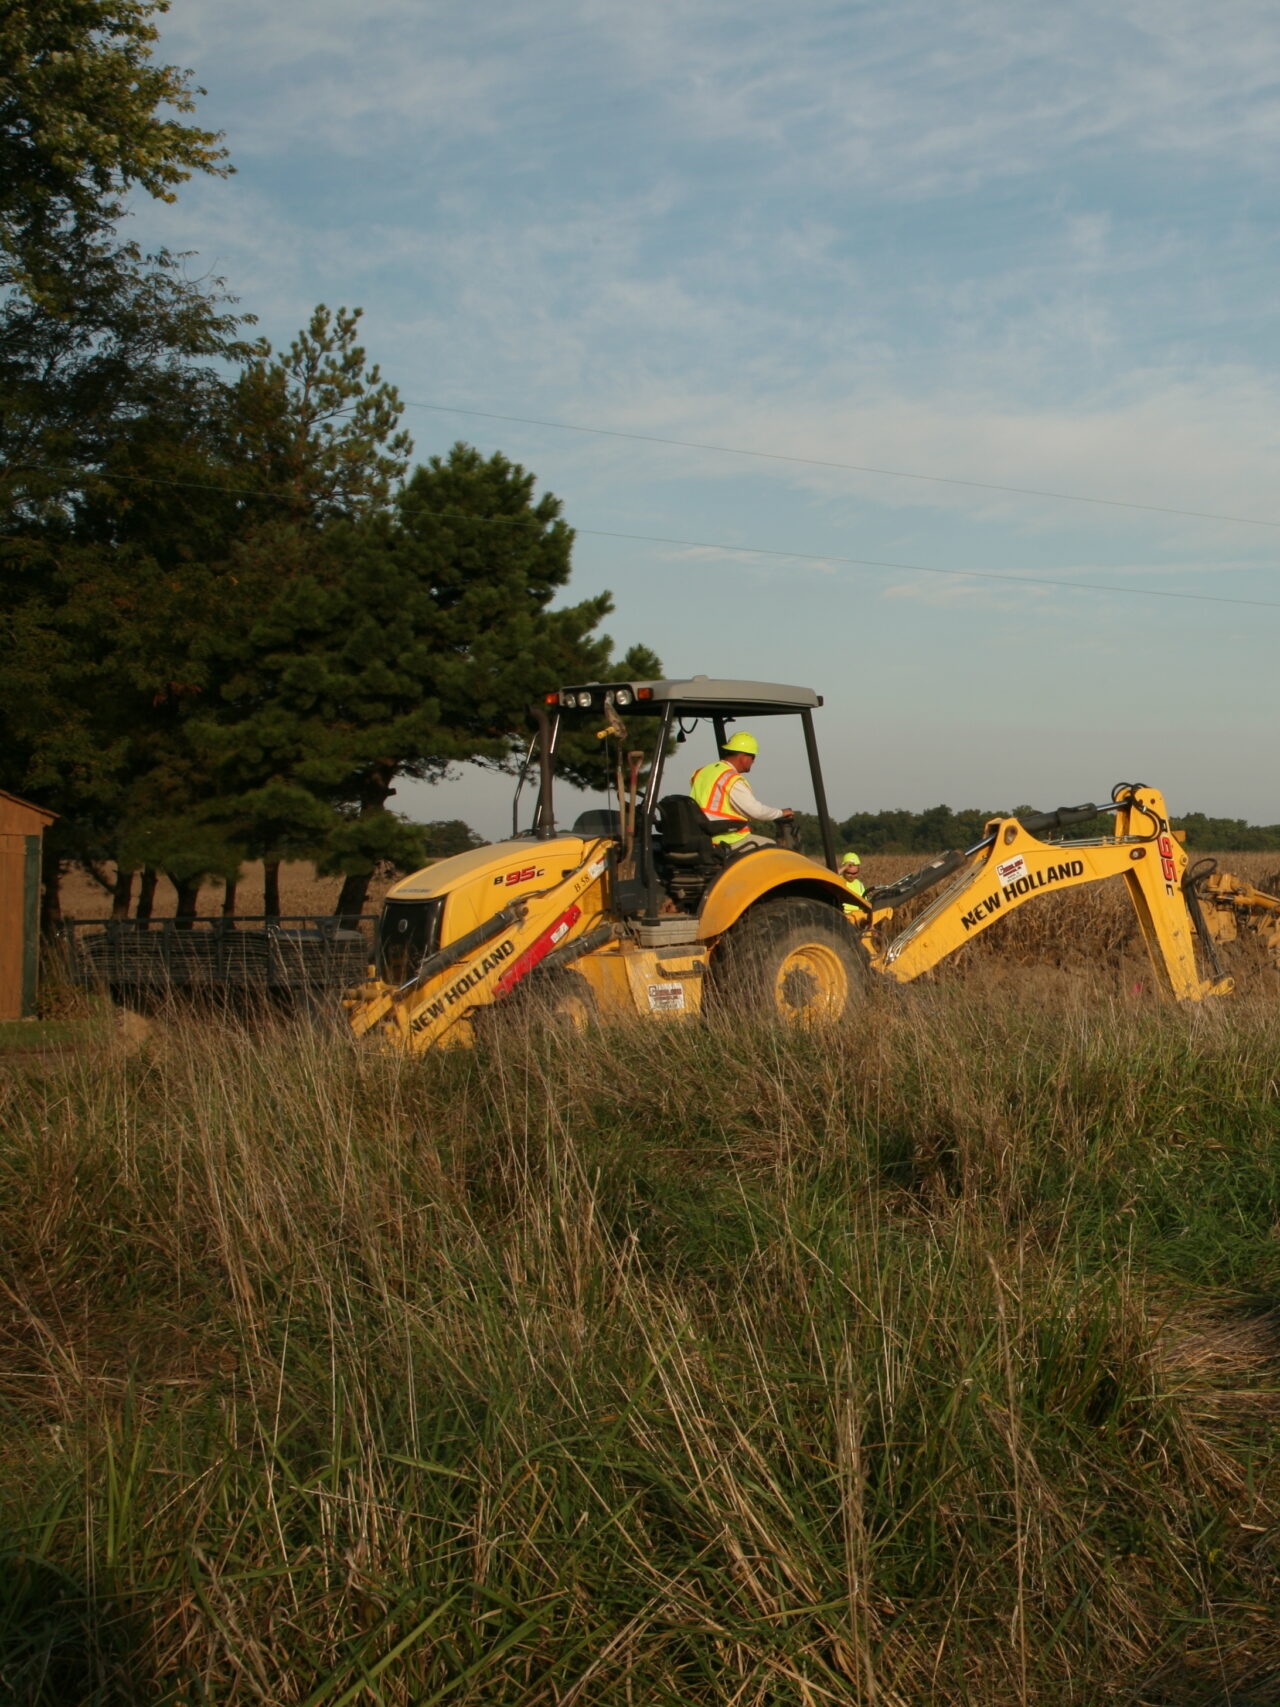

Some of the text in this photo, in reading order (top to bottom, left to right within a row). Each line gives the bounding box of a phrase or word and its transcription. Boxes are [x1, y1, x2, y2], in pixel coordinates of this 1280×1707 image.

[960, 892, 1001, 931] NEW
[1002, 860, 1084, 902] HOLLAND
[410, 939, 516, 1036] NEW HOLLAND
